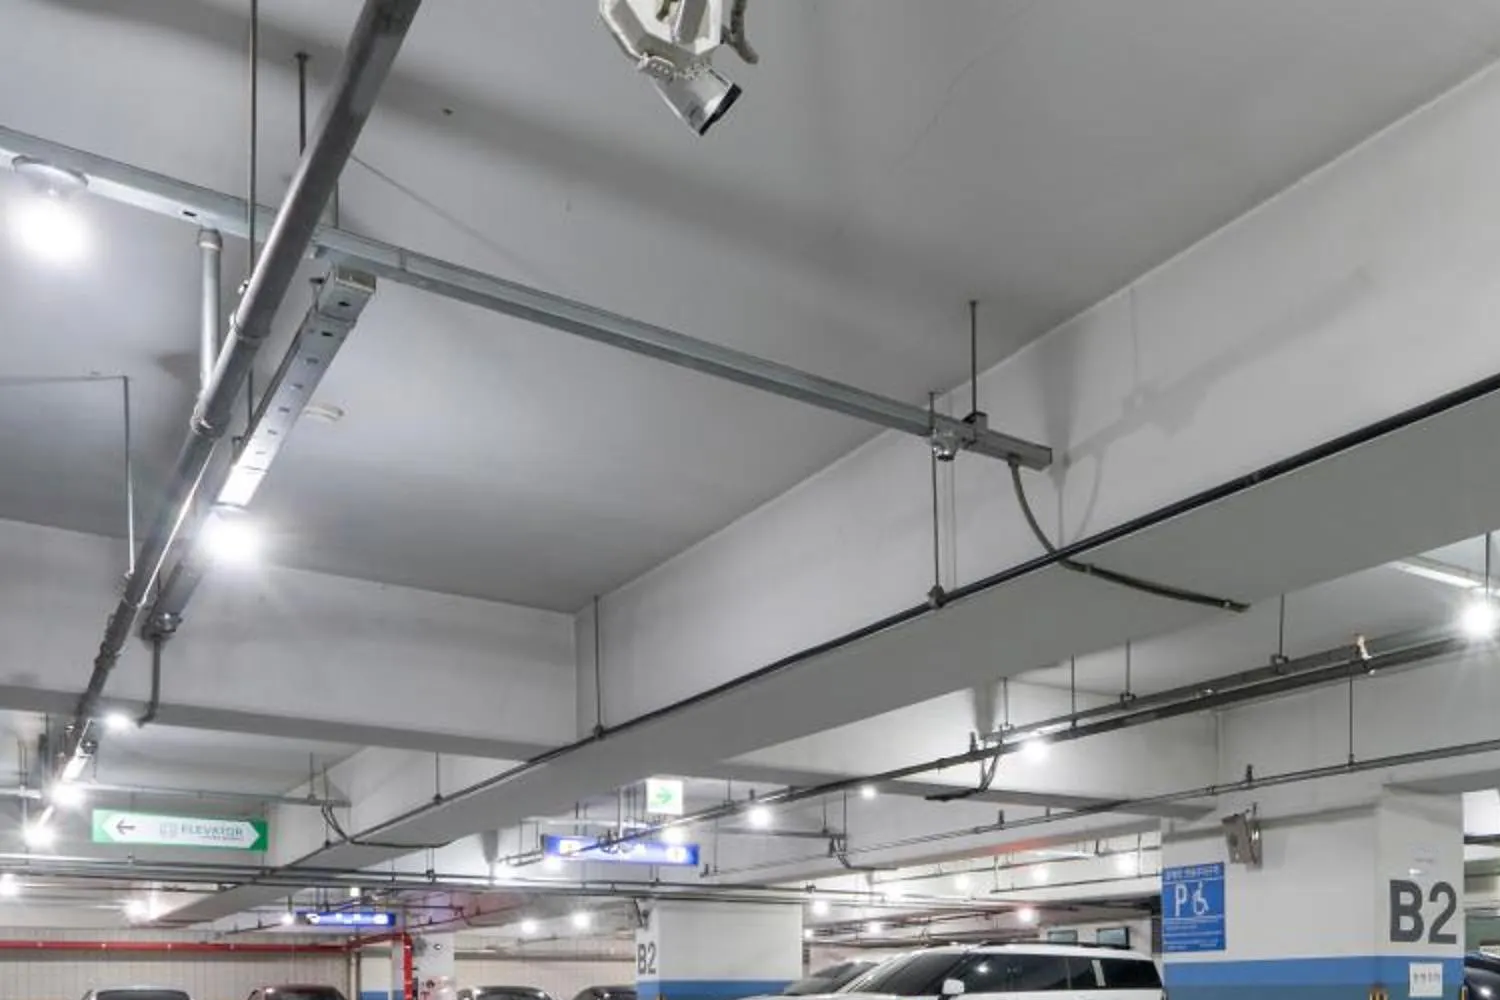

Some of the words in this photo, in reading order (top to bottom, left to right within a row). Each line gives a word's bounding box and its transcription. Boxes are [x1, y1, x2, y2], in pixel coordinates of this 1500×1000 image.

[181, 823, 243, 836] ELEVATOR
[1175, 884, 1188, 917] P
[1390, 879, 1457, 944] B2
[637, 941, 657, 975] B2
